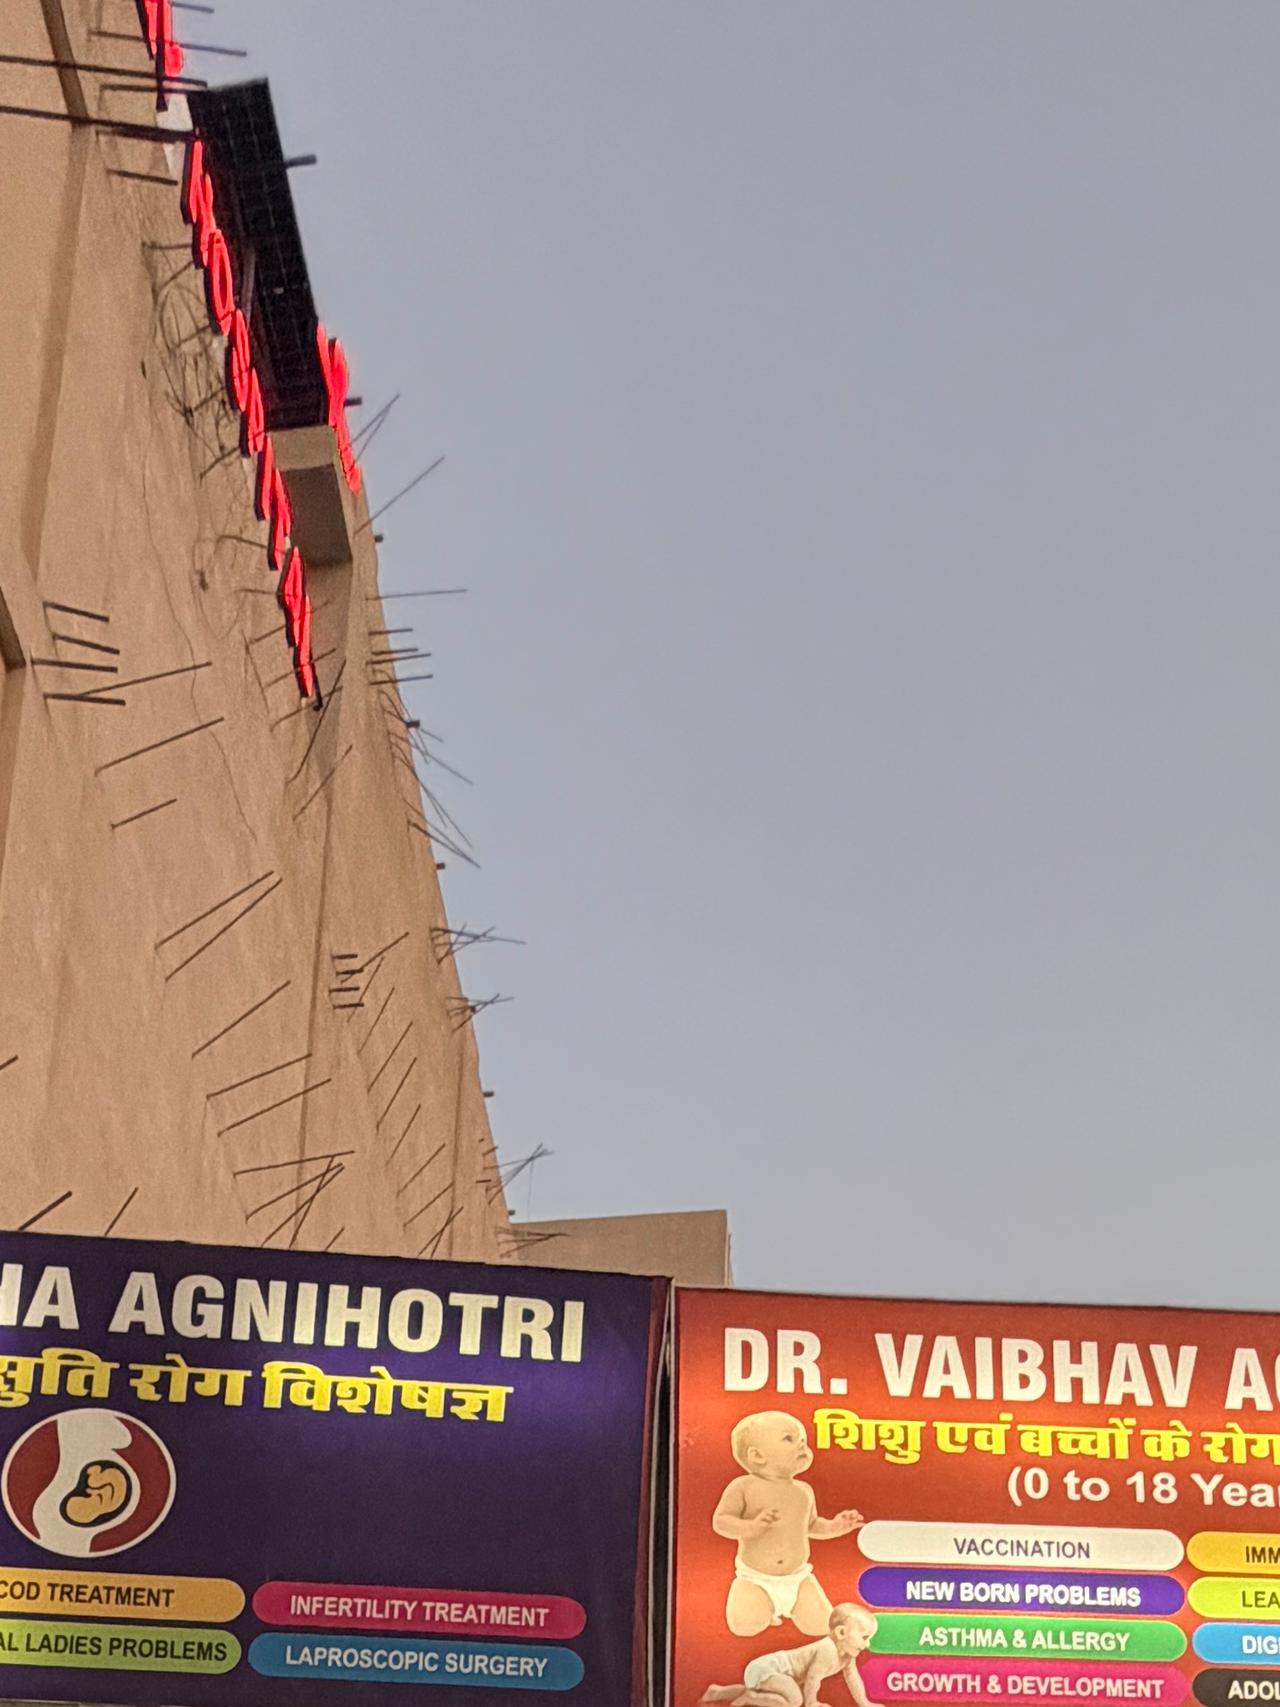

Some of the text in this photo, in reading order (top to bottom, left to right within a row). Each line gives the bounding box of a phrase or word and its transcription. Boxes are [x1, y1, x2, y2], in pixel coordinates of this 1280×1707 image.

[108, 1271, 585, 1362] AGNIHOTRI
[724, 1327, 848, 1395] DR.
[874, 1333, 1198, 1408] VAIBHAV
[129, 1353, 252, 1406] रोग
[262, 1360, 514, 1422] विशेषज्ञ
[813, 1408, 926, 1464] शिशु
[933, 1413, 1014, 1454] एवं
[1017, 1417, 1136, 1460] बच्चों
[1141, 1420, 1193, 1462] के
[1007, 1466, 1049, 1506] (0
[1064, 1469, 1110, 1502] to
[1126, 1471, 1178, 1504] 18
[953, 1537, 1091, 1559] VACCINATION
[46, 1582, 175, 1608] TREATMENT
[906, 1580, 1141, 1607] NEW BORN PROBLEMS
[290, 1594, 549, 1628] INFERTILITY TREATMENT
[25, 1632, 102, 1656] LADIES
[109, 1637, 227, 1662] PROBLEMS
[919, 1626, 1130, 1653] ASTHMA & ALLERGY
[285, 1645, 548, 1678] LAPROSCOPIC SURGERY
[886, 1671, 1164, 1699] GROWTH & DEVELOPMENT
